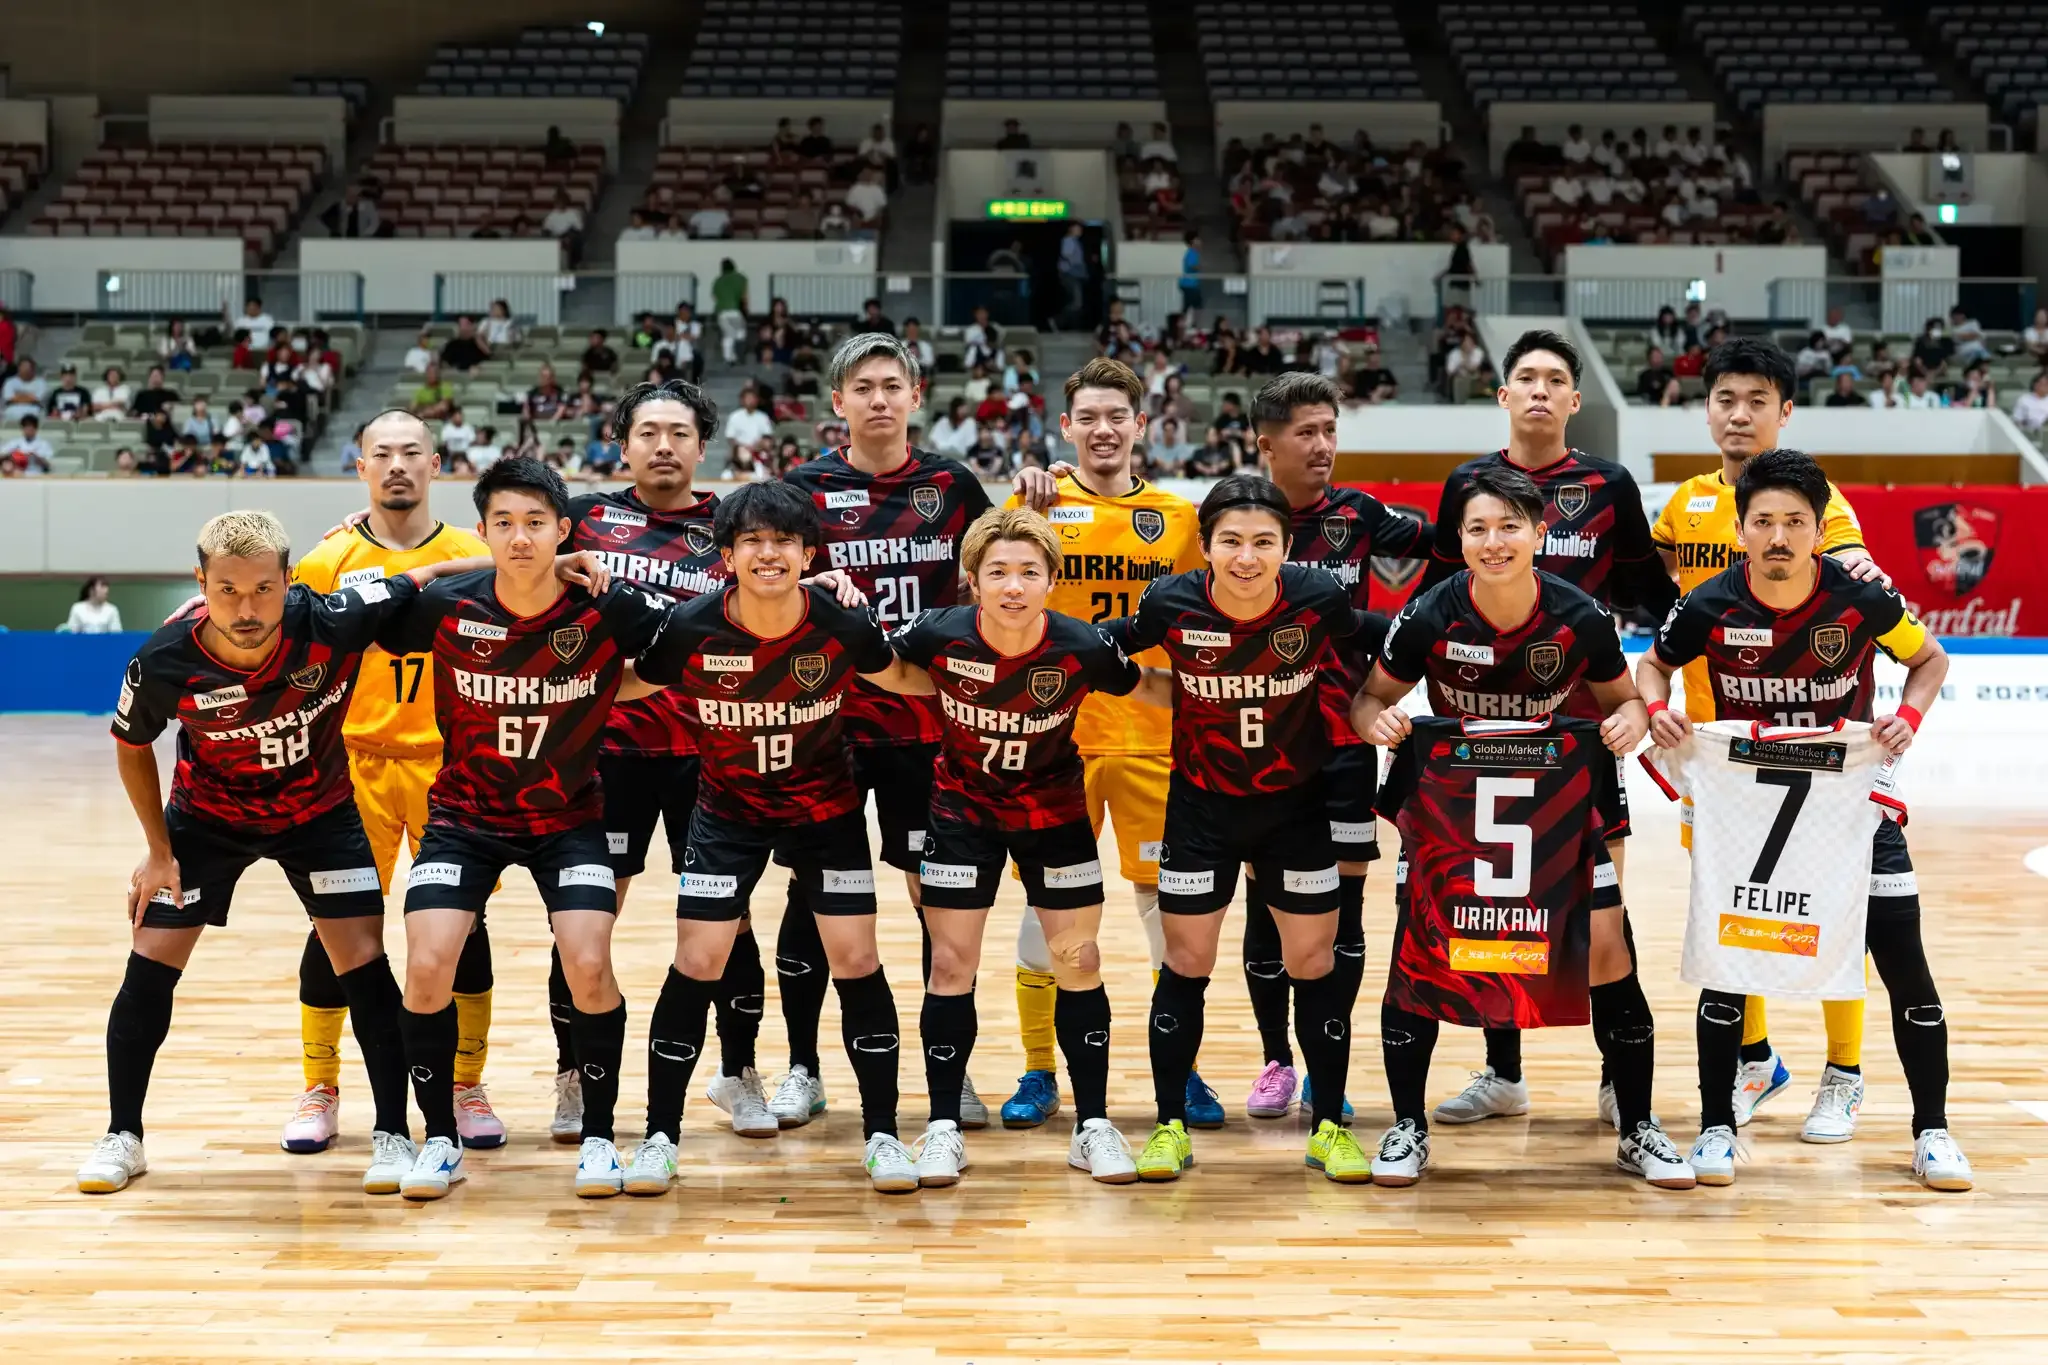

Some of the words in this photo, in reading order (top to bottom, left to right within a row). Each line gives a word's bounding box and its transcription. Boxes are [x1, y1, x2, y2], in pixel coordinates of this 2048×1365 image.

[831, 494, 865, 504] HAZOU
[609, 511, 643, 523] HAZOU
[1053, 511, 1088, 519] HAZOU
[1546, 534, 1598, 559] bullet
[345, 571, 380, 584] HAZOU
[875, 576, 921, 622] 20
[1091, 592, 1129, 626] 21
[463, 624, 501, 637] HAZOU
[1188, 633, 1225, 642] HAZOU
[1730, 633, 1767, 642] HAZOU
[1452, 647, 1489, 660] HAZOU
[709, 658, 748, 667] HAZOU
[953, 661, 990, 677] HAZOU
[389, 658, 425, 704] 17
[201, 689, 240, 706] HAZOU
[1240, 707, 1264, 748] 6
[498, 716, 549, 760] 67
[752, 733, 794, 774] 19
[979, 736, 1028, 774] 78
[1473, 744, 1506, 754] Global
[1508, 745, 1543, 755] Market
[1754, 741, 1787, 753] Global
[1789, 745, 1825, 758] Market
[1748, 767, 1812, 885] 7
[1474, 777, 1535, 898] 5
[444, 869, 457, 877] VIE
[926, 868, 944, 876] C'EST
[1163, 876, 1181, 884] C'EST
[686, 879, 705, 887] C'EST
[1733, 885, 1812, 917] FELIPE
[1453, 906, 1549, 933] URAKAMI
